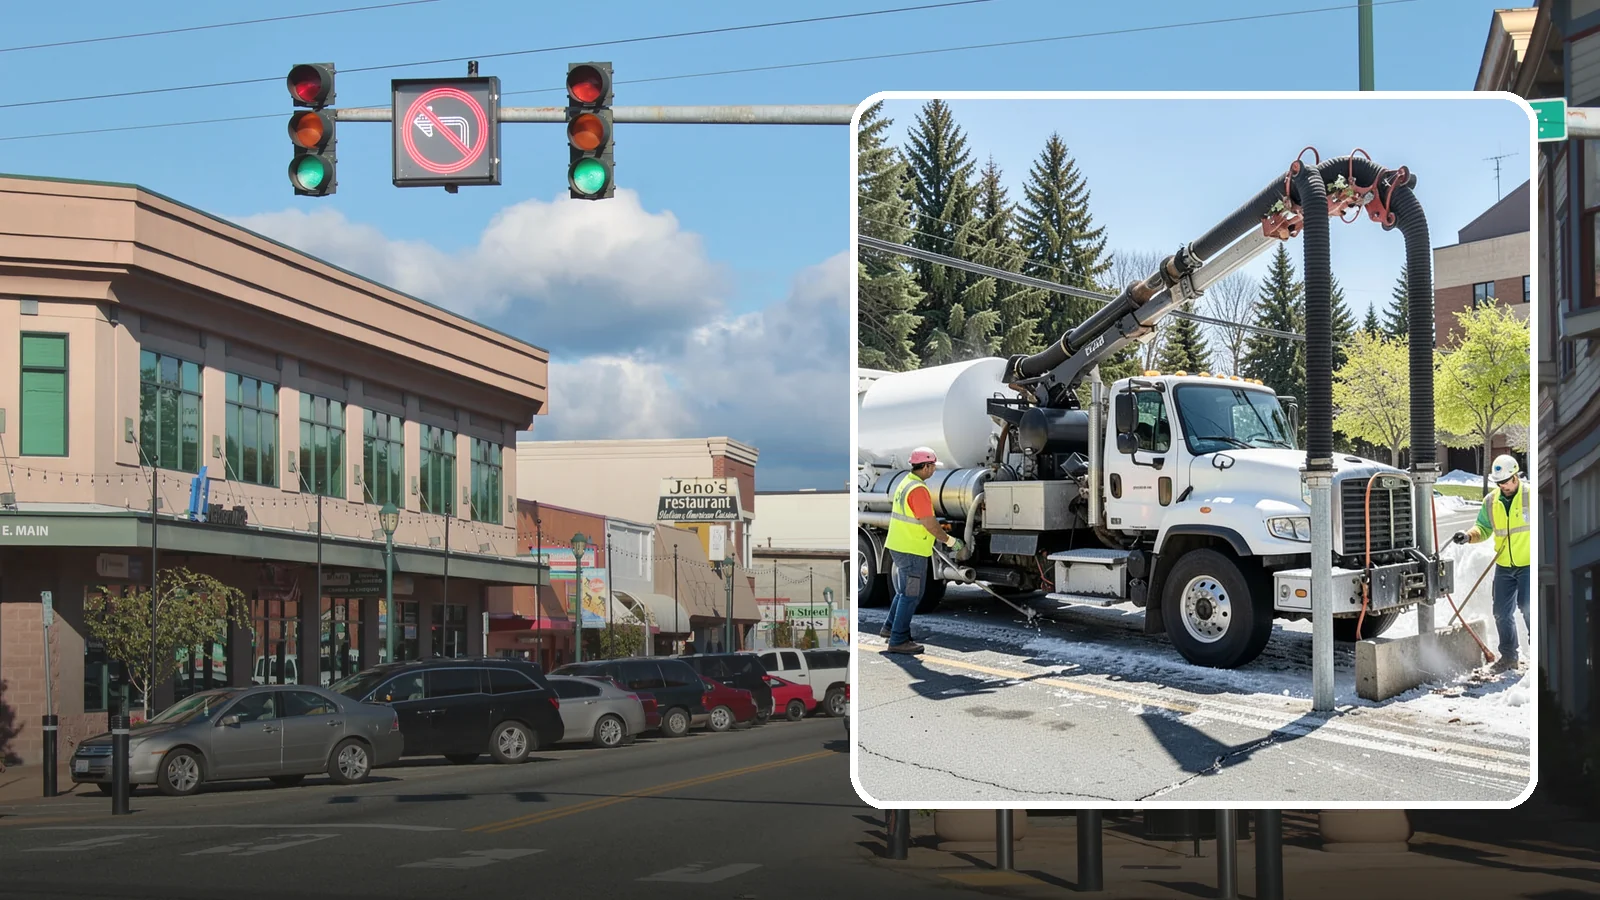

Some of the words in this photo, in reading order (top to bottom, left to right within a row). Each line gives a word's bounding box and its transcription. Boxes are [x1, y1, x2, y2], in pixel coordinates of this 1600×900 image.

[670, 480, 727, 494] Jeno's
[665, 496, 731, 509] restaurant
[658, 510, 681, 519] Italian
[686, 510, 714, 519] American
[715, 509, 738, 519] Cuisine
[2, 525, 13, 536] E.
[15, 525, 49, 536] MAIN
[797, 607, 828, 616] Street
